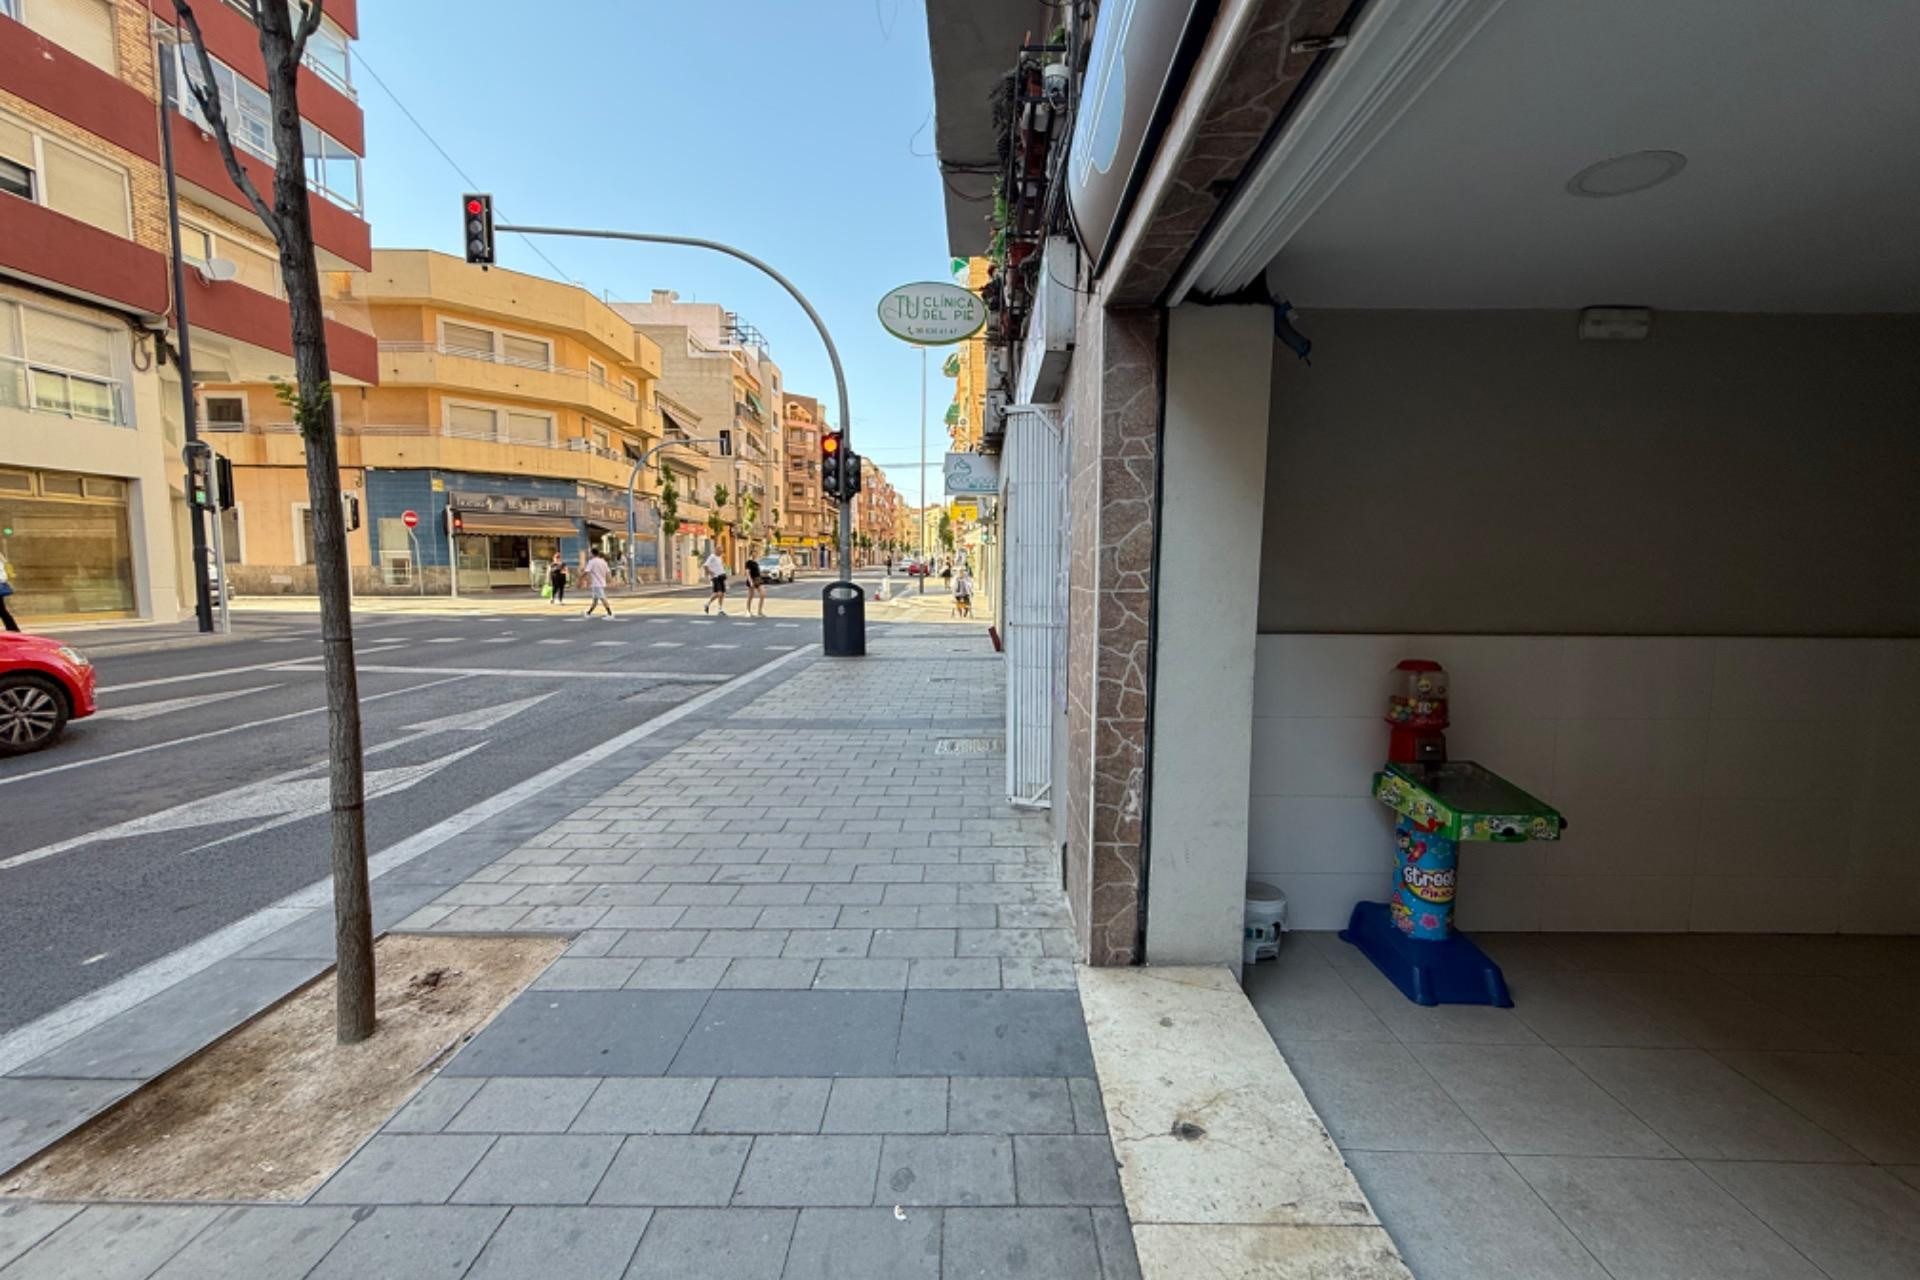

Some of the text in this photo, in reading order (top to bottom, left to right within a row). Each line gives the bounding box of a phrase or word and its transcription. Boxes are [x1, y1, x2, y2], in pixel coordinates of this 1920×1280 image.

[895, 295, 919, 319] TU
[923, 294, 974, 309] CLÍNICA
[922, 309, 974, 321] DEL PIE
